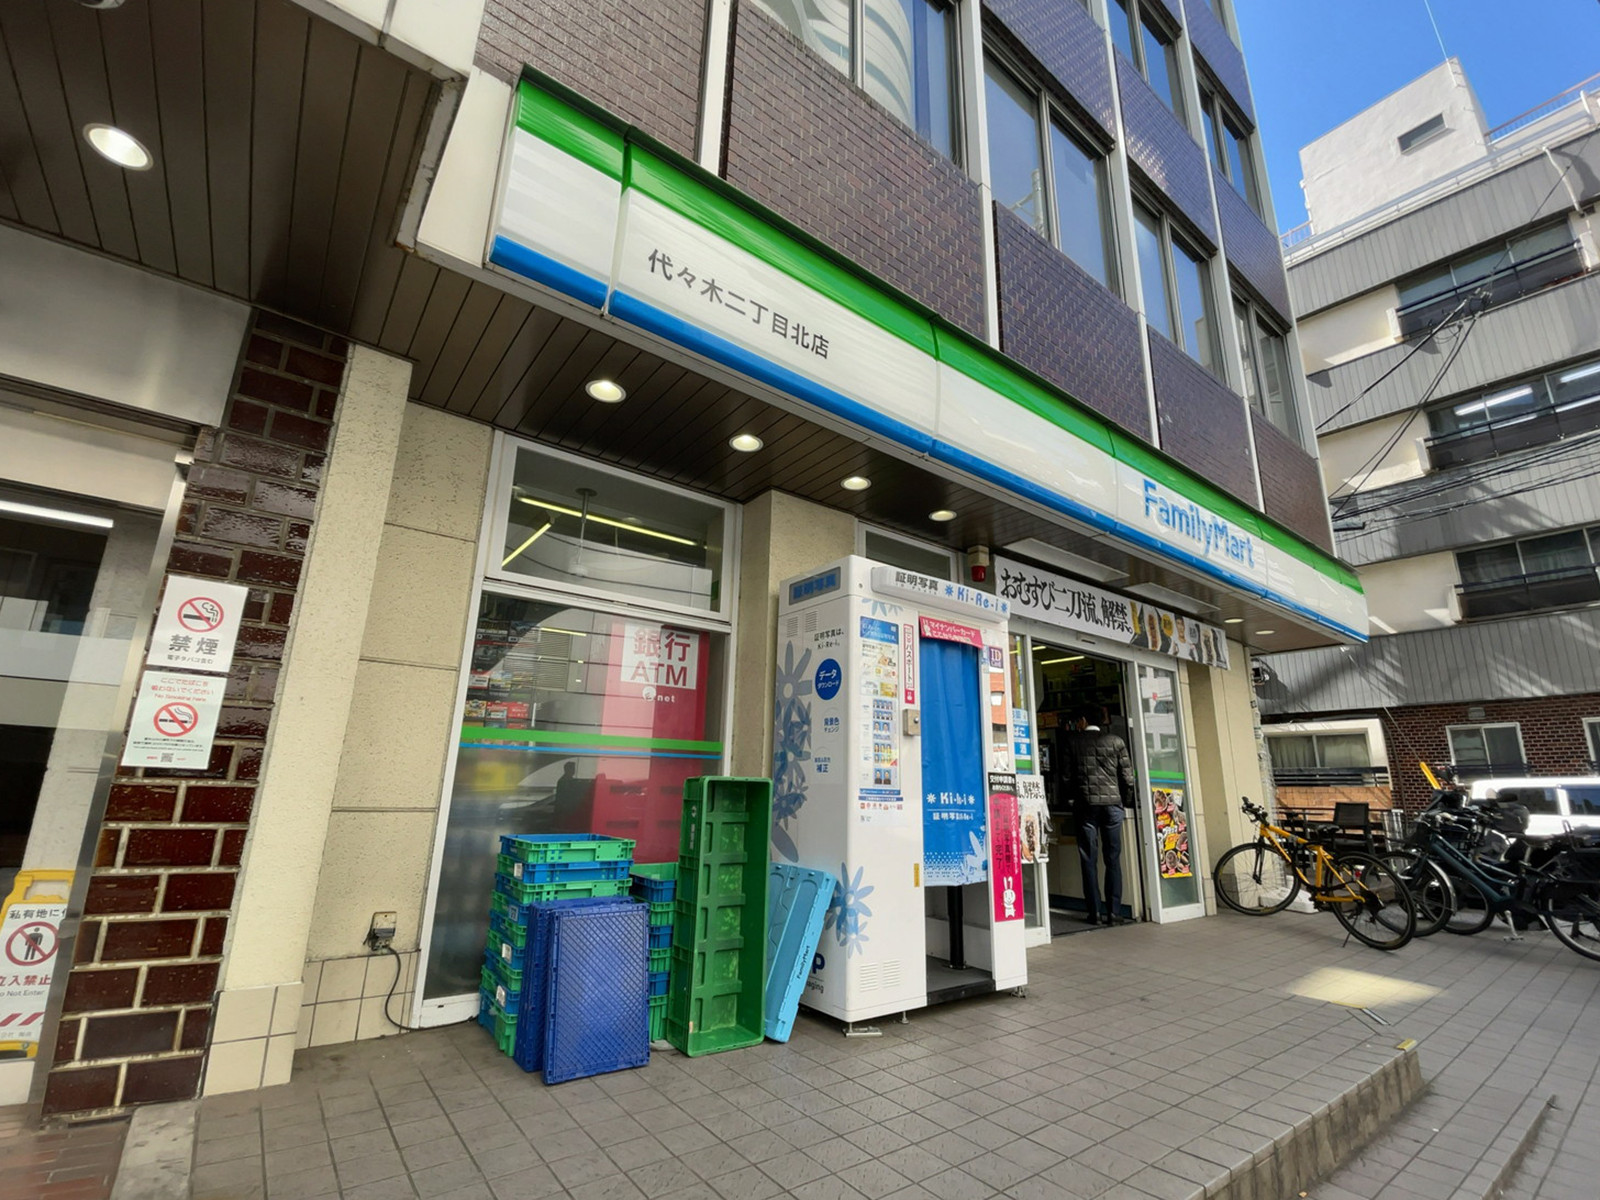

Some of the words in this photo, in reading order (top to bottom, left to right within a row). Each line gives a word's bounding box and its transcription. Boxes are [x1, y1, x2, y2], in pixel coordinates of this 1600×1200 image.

[648, 249, 830, 360] 代々木二丁目北店
[1143, 478, 1255, 569] FamilyMart
[895, 571, 939, 591] 証明写真
[957, 586, 999, 611] Ki-Re-i
[1000, 568, 1133, 635] おむすび二刀流、解禁。
[929, 621, 976, 637] マイナンバーカード
[168, 634, 219, 656] 禁煙
[633, 628, 691, 662] 銀行
[167, 654, 214, 664] 電子タバコ含む
[990, 648, 1002, 662] ID
[630, 660, 687, 687] ATM
[818, 668, 837, 681] データ
[151, 685, 214, 695] 吸わないでください
[817, 680, 839, 690] ダウンロード
[824, 717, 840, 726] 背景色
[817, 764, 829, 773] 補正
[9, 908, 67, 919] 私有地に
[796, 945, 811, 979] FamilyMart
[0, 974, 51, 987] 立入禁止
